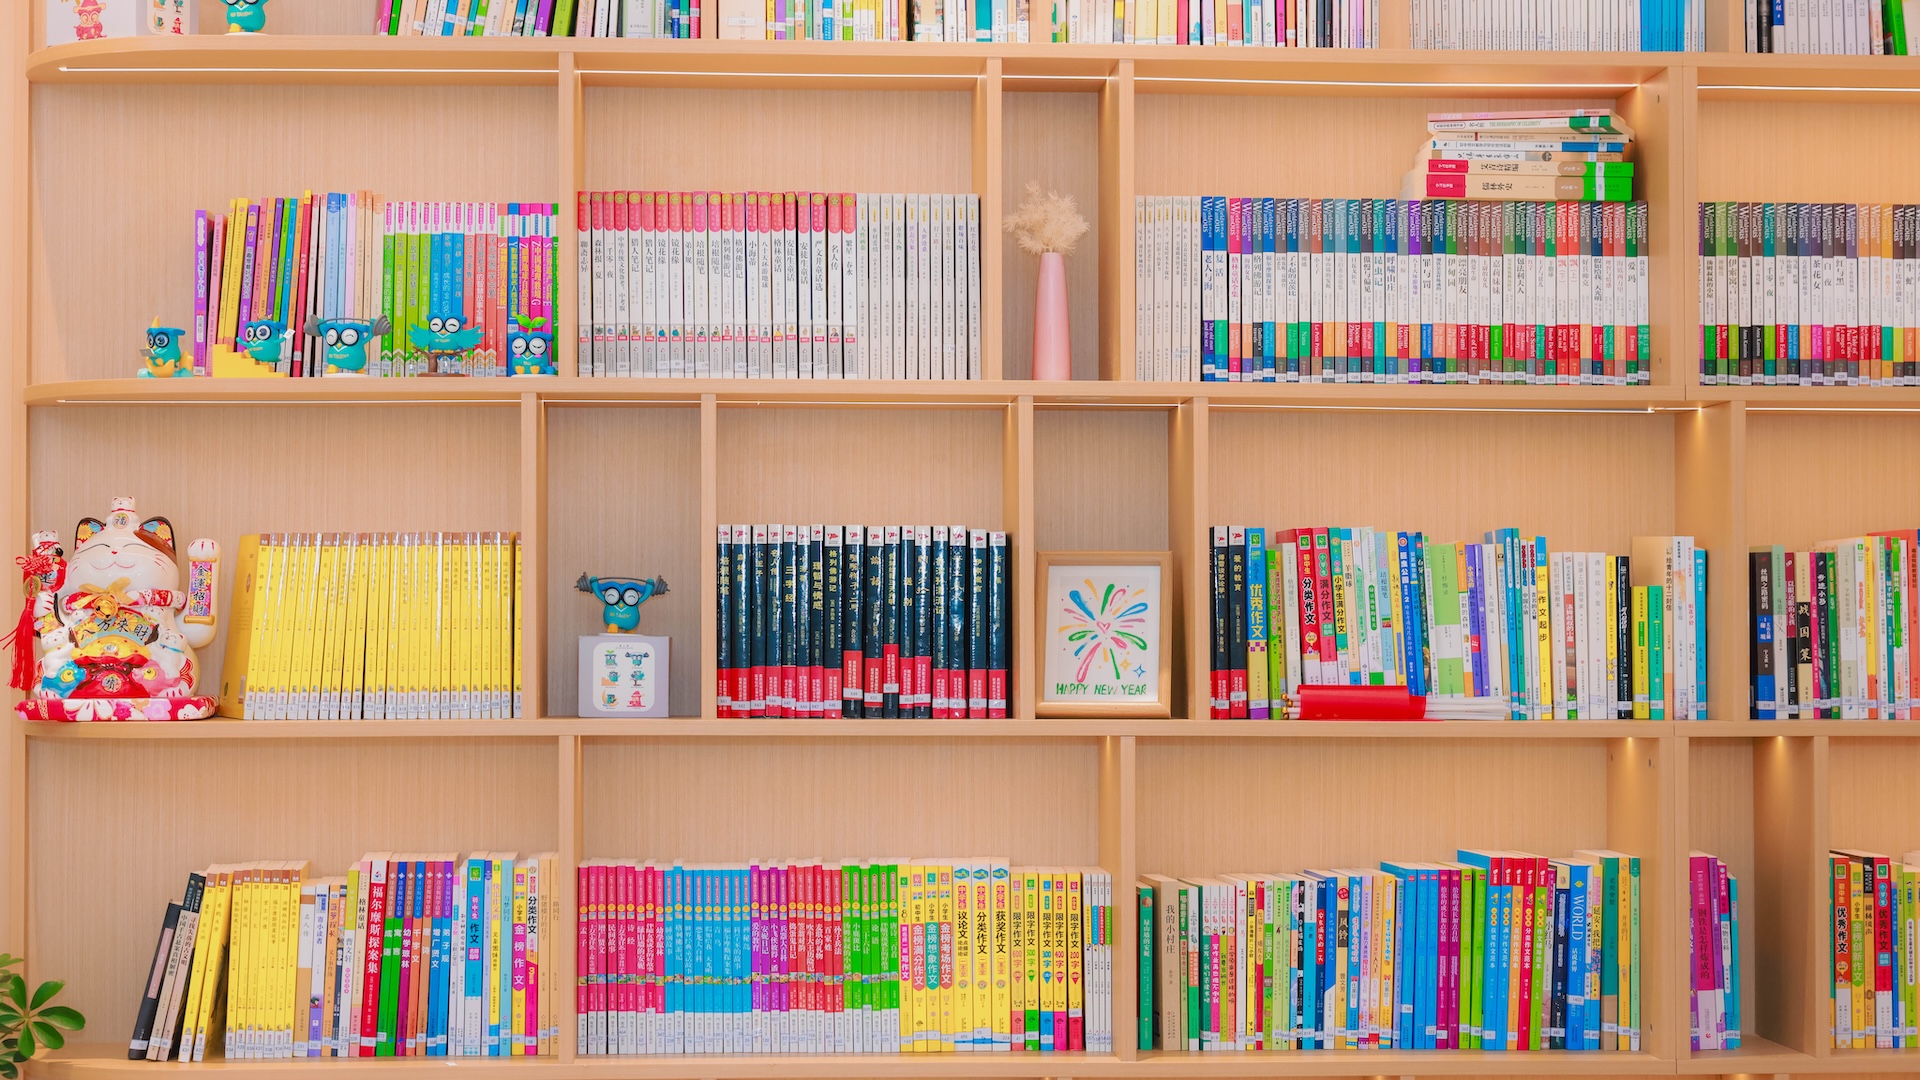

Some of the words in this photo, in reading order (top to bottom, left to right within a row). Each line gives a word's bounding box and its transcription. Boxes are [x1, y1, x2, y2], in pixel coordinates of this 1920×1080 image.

[774, 239, 782, 273] 格林童话
[787, 240, 795, 282] 安徒生童话
[800, 242, 809, 285] 安徒生童话
[815, 240, 824, 292] 严文井童话选
[1204, 255, 1212, 290] 老人与海
[1374, 256, 1382, 290] 昆虫记
[1387, 255, 1396, 292] 呼啸山庄
[1423, 259, 1432, 289] 罪与罚
[1627, 262, 1636, 283] 爱玛
[1836, 258, 1844, 286] 红与黑
[1254, 255, 1262, 296] 格列佛游记
[1364, 256, 1372, 293] 傲慢与偏见
[1458, 258, 1467, 294] 漂亮朋友
[1492, 260, 1500, 294] 嘉莉妹妹
[1517, 258, 1525, 294] 包法利夫人
[1813, 260, 1822, 290] 茶花女
[1824, 263, 1832, 287] 白夜
[1906, 263, 1914, 286] 牛虻
[785, 566, 794, 603] 三字经
[829, 550, 837, 592] 格列佛游记
[1234, 555, 1242, 592] 爱的教育
[1250, 584, 1264, 639] 优秀作文
[1302, 578, 1316, 626] 分类作文
[1320, 580, 1332, 621] 满分作文
[1335, 576, 1346, 632] 小学生满分作文
[1538, 596, 1548, 641] 作文起步
[1798, 604, 1811, 660] 战国策
[1056, 683, 1090, 695] HAPPY
[1094, 684, 1118, 696] NEW
[1121, 684, 1147, 696] YEAR
[329, 903, 338, 938] 菠萝探长
[358, 898, 367, 930] 格林童话
[471, 896, 480, 920] 初中生
[528, 896, 537, 935] 分类作文
[958, 911, 968, 939] 议论文
[1572, 895, 1584, 940] WORLD
[367, 887, 384, 974] 福尔摩斯探案集
[383, 930, 392, 956] 成语
[392, 929, 402, 956] 寓言
[412, 930, 421, 963] 千字文
[441, 930, 450, 963] 弟子规
[470, 924, 479, 944] 作文
[598, 924, 606, 954] 增广贤文
[977, 912, 987, 955] 分类作文
[996, 911, 1007, 954] 获奖作文
[1014, 912, 1022, 948] 限字作文
[1027, 912, 1035, 946] 限字作文
[1043, 913, 1052, 948] 限字作文
[1056, 913, 1064, 948] 限字作文
[1070, 914, 1079, 949] 限字作文
[1166, 904, 1176, 954] 我的小村庄
[1338, 917, 1348, 941] 风铃
[1698, 908, 1710, 980] 钢铁是怎样炼成的
[1837, 907, 1848, 955] 优秀作文
[1878, 908, 1888, 950] 优秀作文
[401, 930, 412, 968] 幼学琼林
[431, 930, 441, 968] 增广贤文
[514, 926, 525, 985] 金榜作文
[913, 926, 924, 986] 金榜满分作文
[926, 924, 938, 984] 金榜想象作文
[940, 924, 952, 984] 金榜考场作文
[1013, 950, 1022, 968] 600字
[1027, 949, 1036, 967] 500字
[1042, 951, 1052, 968] 300字
[1055, 951, 1064, 968] 400字
[1070, 951, 1079, 968] 200字
[1852, 922, 1862, 983] 金榜创新作文
